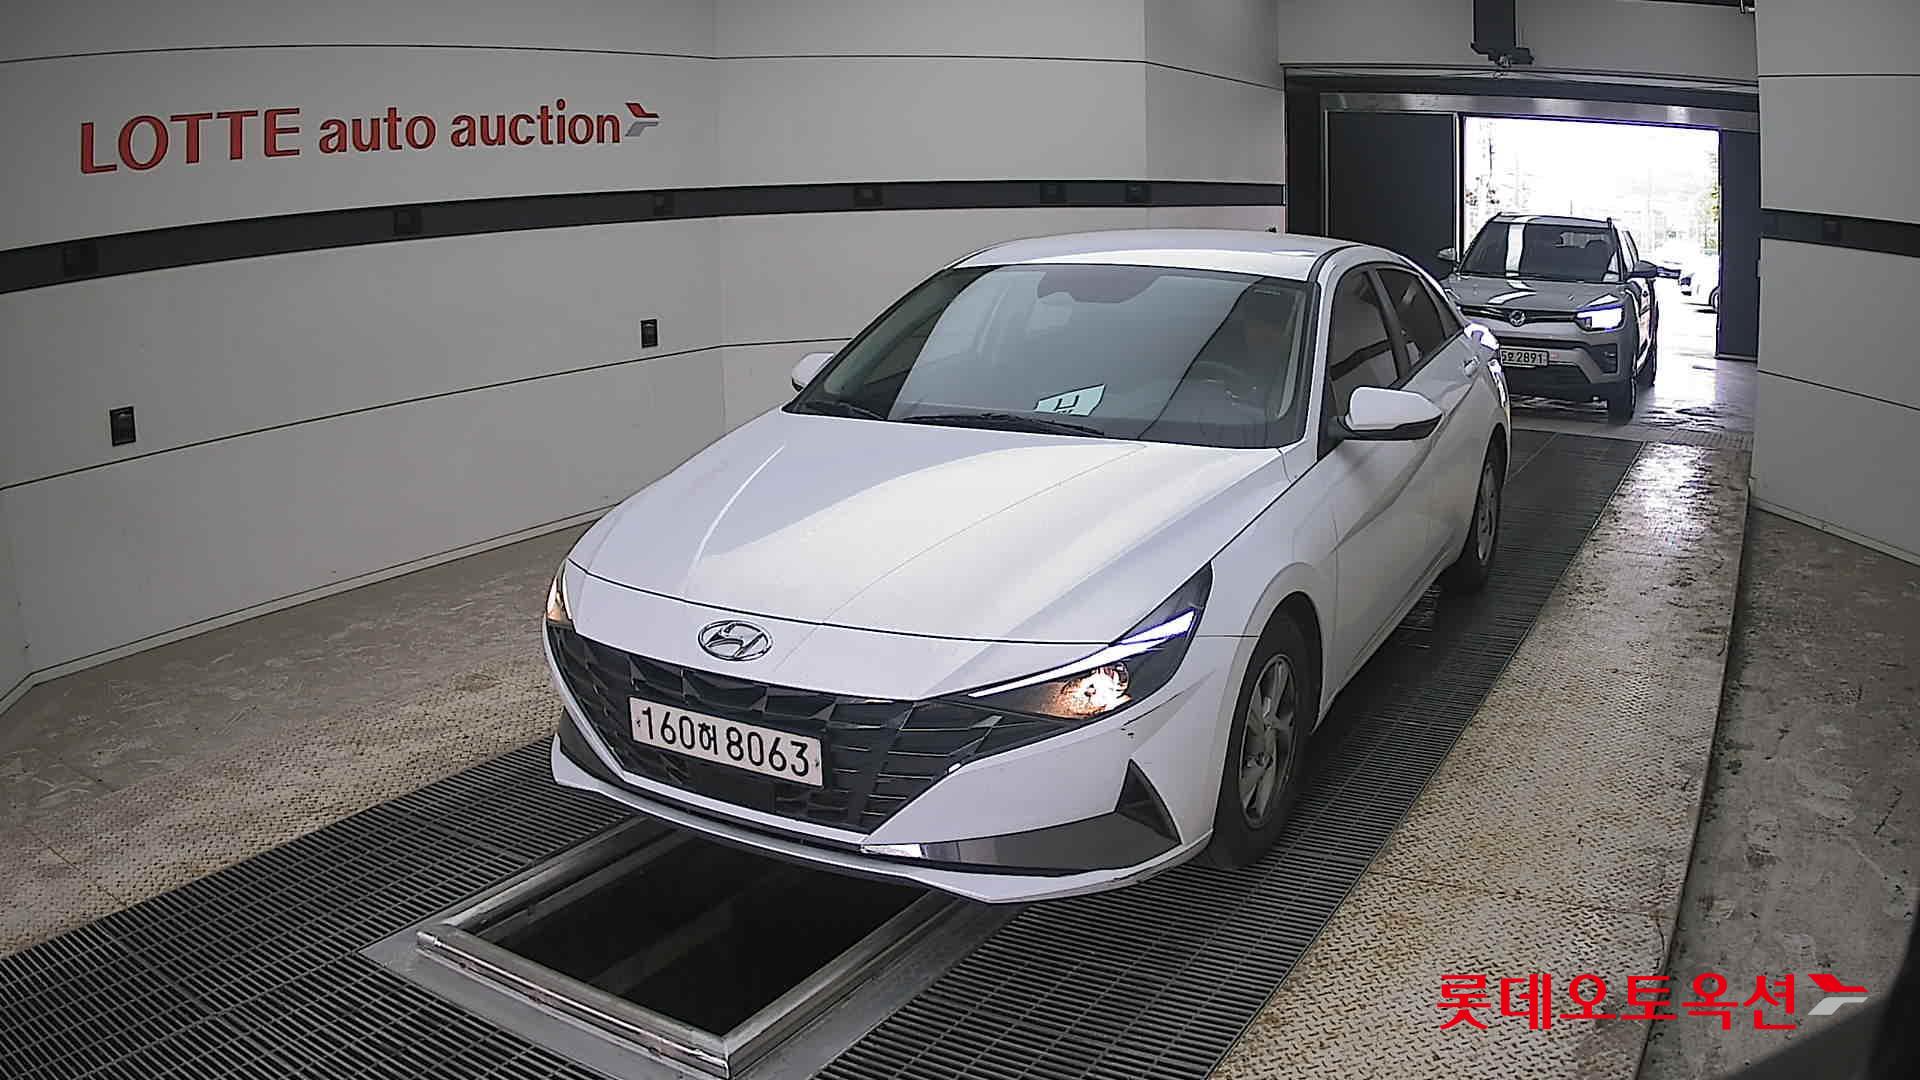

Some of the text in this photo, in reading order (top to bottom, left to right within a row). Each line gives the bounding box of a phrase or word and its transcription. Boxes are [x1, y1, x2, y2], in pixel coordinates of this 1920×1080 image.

[81, 99, 621, 175] LOTTE auto auction
[1516, 351, 1543, 364] 2891
[726, 726, 809, 777] 8063
